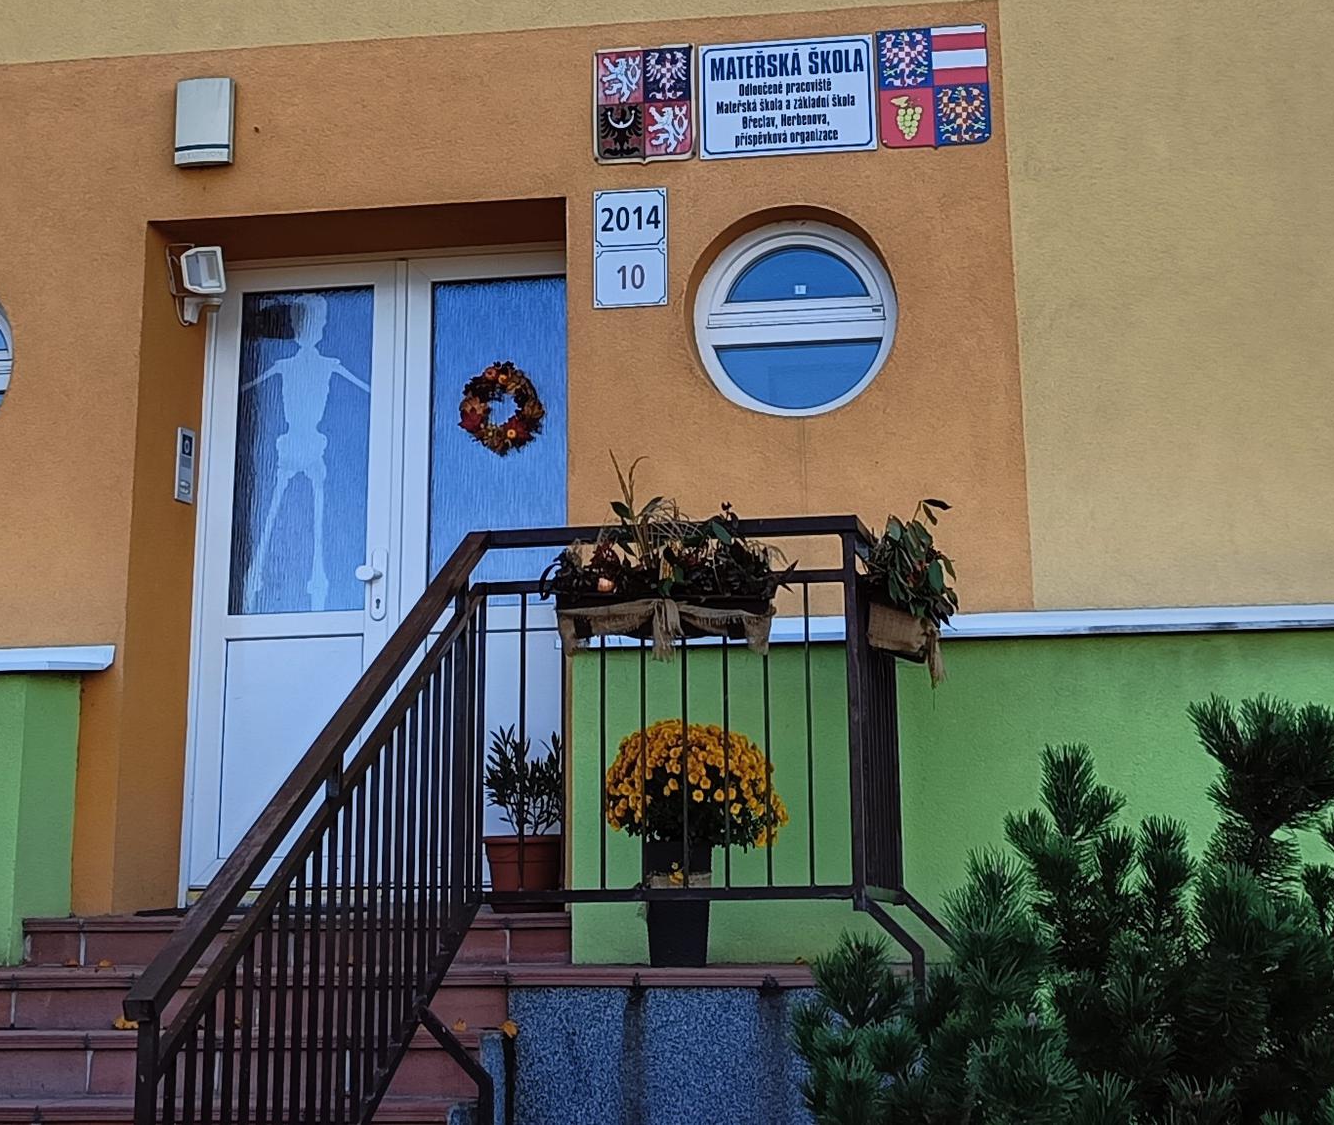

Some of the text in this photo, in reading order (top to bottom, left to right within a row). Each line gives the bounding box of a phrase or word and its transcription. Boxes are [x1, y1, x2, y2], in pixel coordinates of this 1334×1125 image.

[710, 46, 864, 81] MATEŘSKÁ ŠKOLA
[739, 78, 832, 96] Odloučené pracoviště
[716, 94, 856, 114] Mateřská škola a základní škola
[742, 113, 830, 129] Břeclav, Herbenova,
[735, 128, 839, 148] příspěvková organizace
[600, 205, 661, 232] 2014
[617, 264, 645, 290] 10
